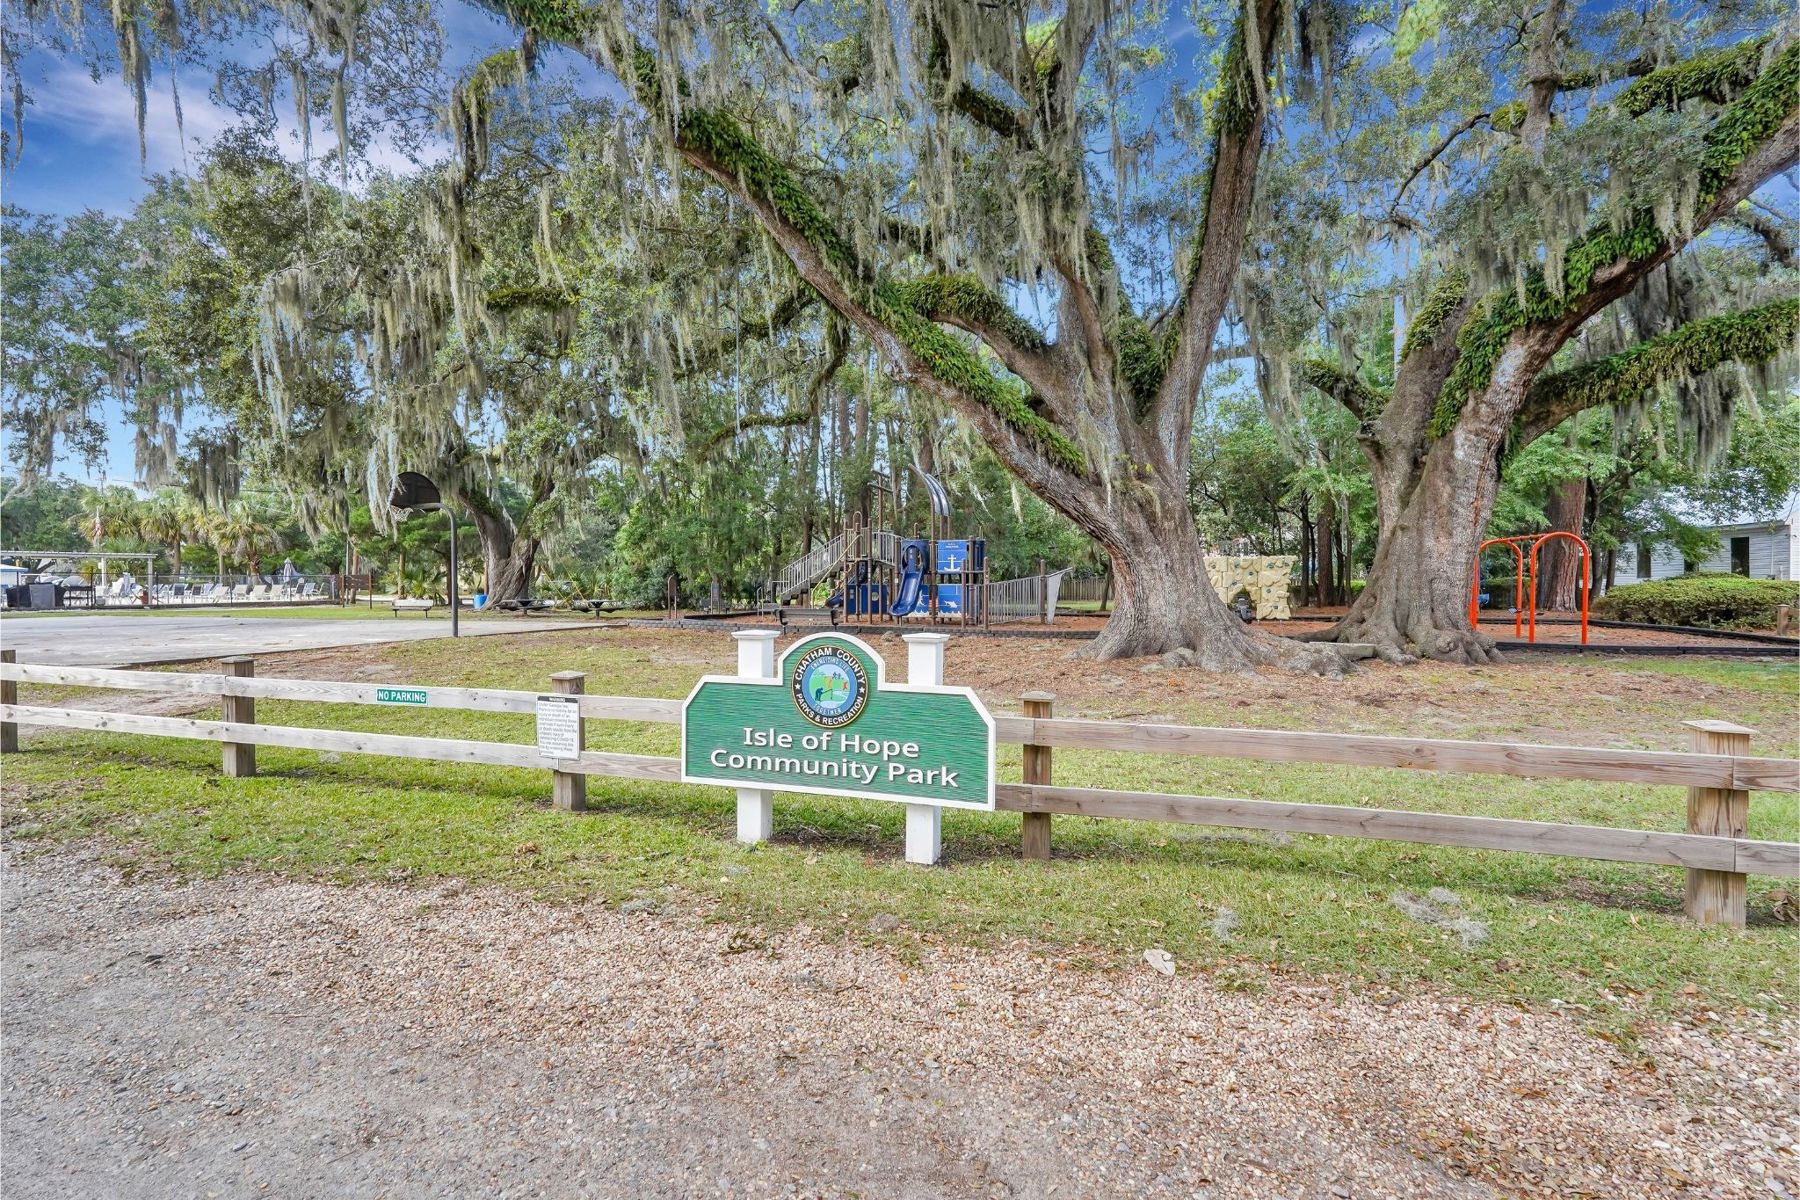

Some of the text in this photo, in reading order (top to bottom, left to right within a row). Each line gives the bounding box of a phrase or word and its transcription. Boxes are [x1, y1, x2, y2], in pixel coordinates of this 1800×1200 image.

[795, 647, 866, 684] CHATHAM COUNTY
[378, 690, 426, 702] NO PARKING
[796, 693, 864, 725] PARKS & RECREATION
[743, 727, 920, 761] Isle of Hope
[710, 749, 959, 788] Community Park
